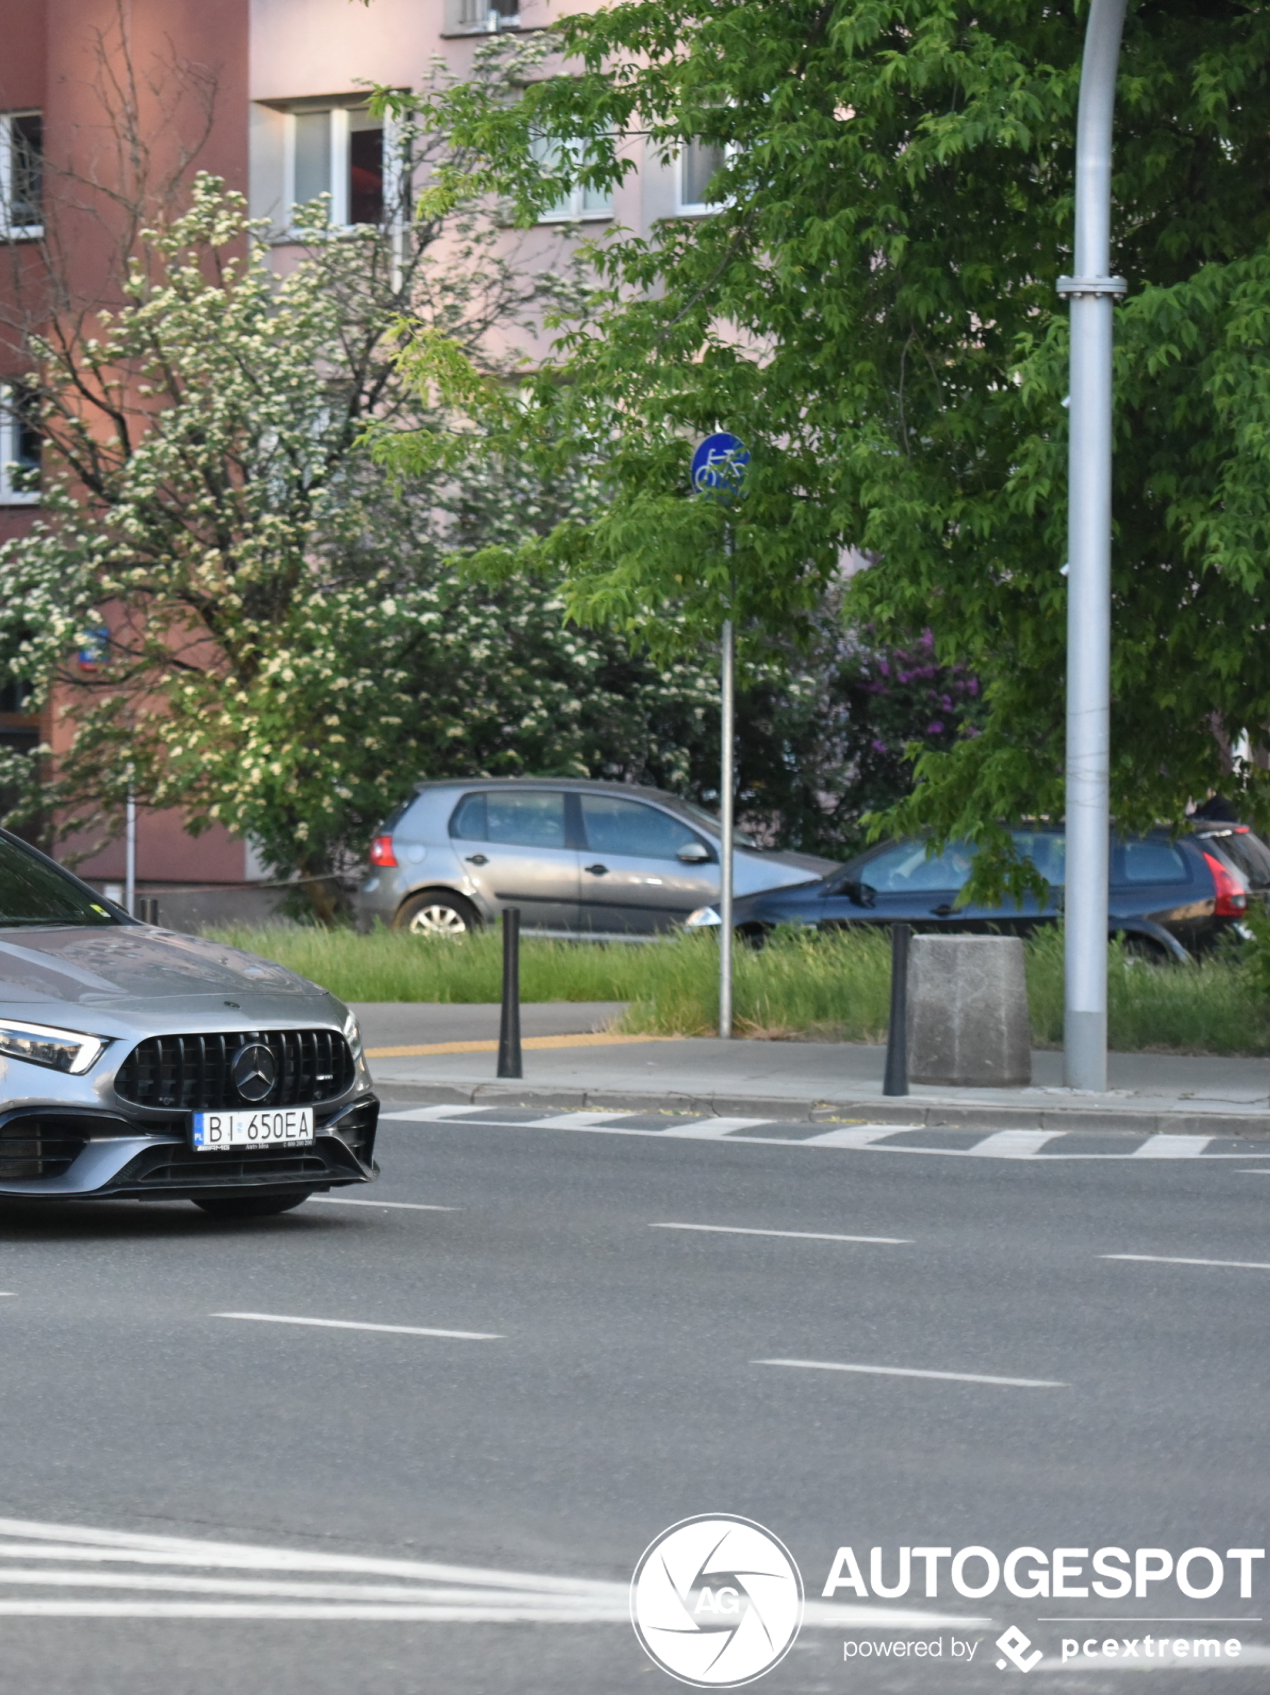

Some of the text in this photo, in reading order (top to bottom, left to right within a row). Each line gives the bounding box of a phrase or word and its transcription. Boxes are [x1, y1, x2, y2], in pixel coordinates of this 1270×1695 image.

[194, 1133, 203, 1141] PL
[209, 1111, 309, 1143] BI 650EA
